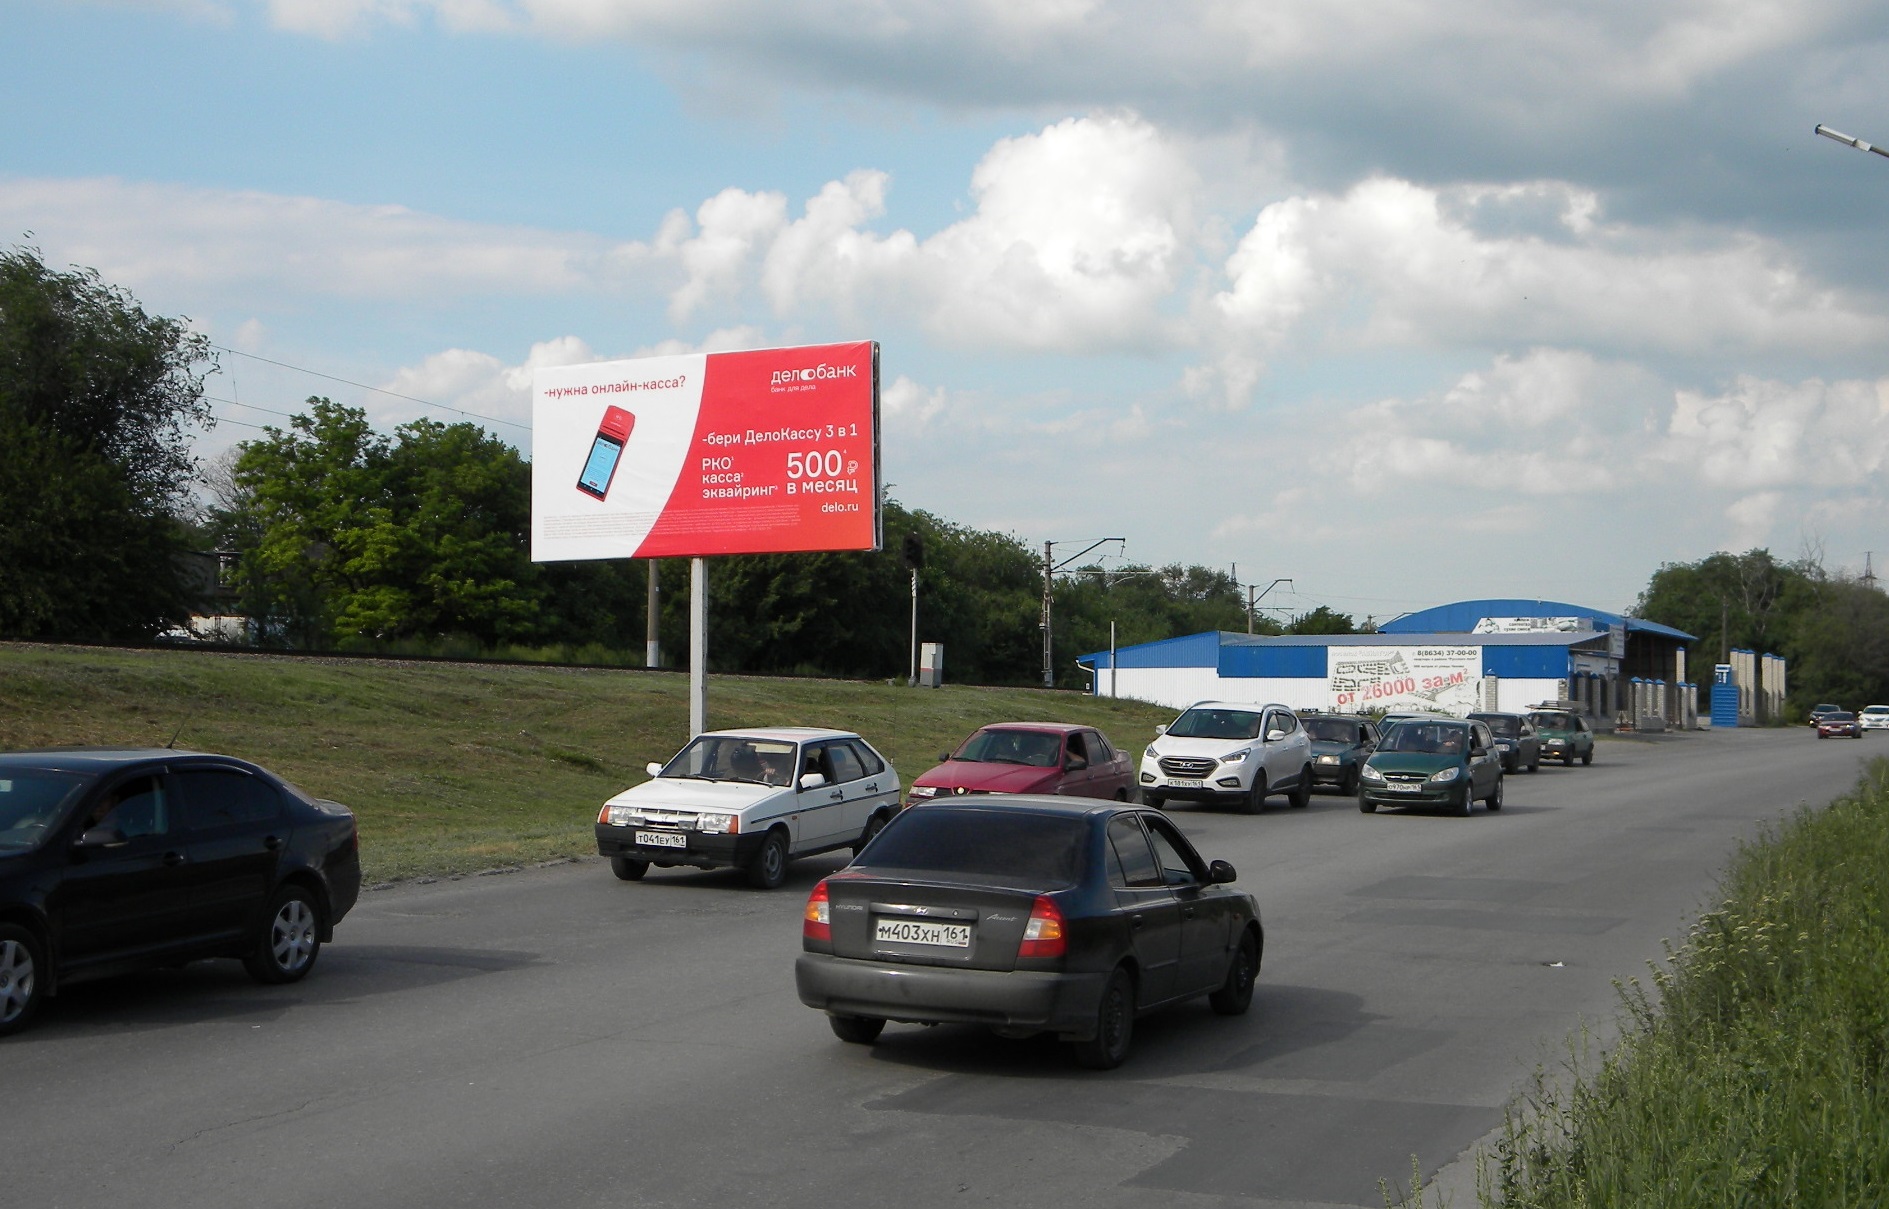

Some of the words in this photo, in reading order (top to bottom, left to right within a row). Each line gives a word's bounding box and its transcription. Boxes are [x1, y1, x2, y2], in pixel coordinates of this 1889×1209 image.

[544, 386, 588, 399] -нужна
[591, 375, 686, 394] онлайн-касса?
[800, 384, 816, 392] дела
[702, 432, 741, 447] -бери
[744, 427, 822, 446] ДелоКассу
[825, 425, 834, 437] 3
[838, 427, 846, 437] в
[849, 423, 858, 436] 1
[787, 482, 796, 494] в
[802, 478, 858, 494] месяц
[822, 502, 858, 513] delo.ru
[1337, 692, 1355, 705] от
[1362, 677, 1416, 700] 26000
[1422, 675, 1444, 689] за
[943, 926, 966, 940] 161
